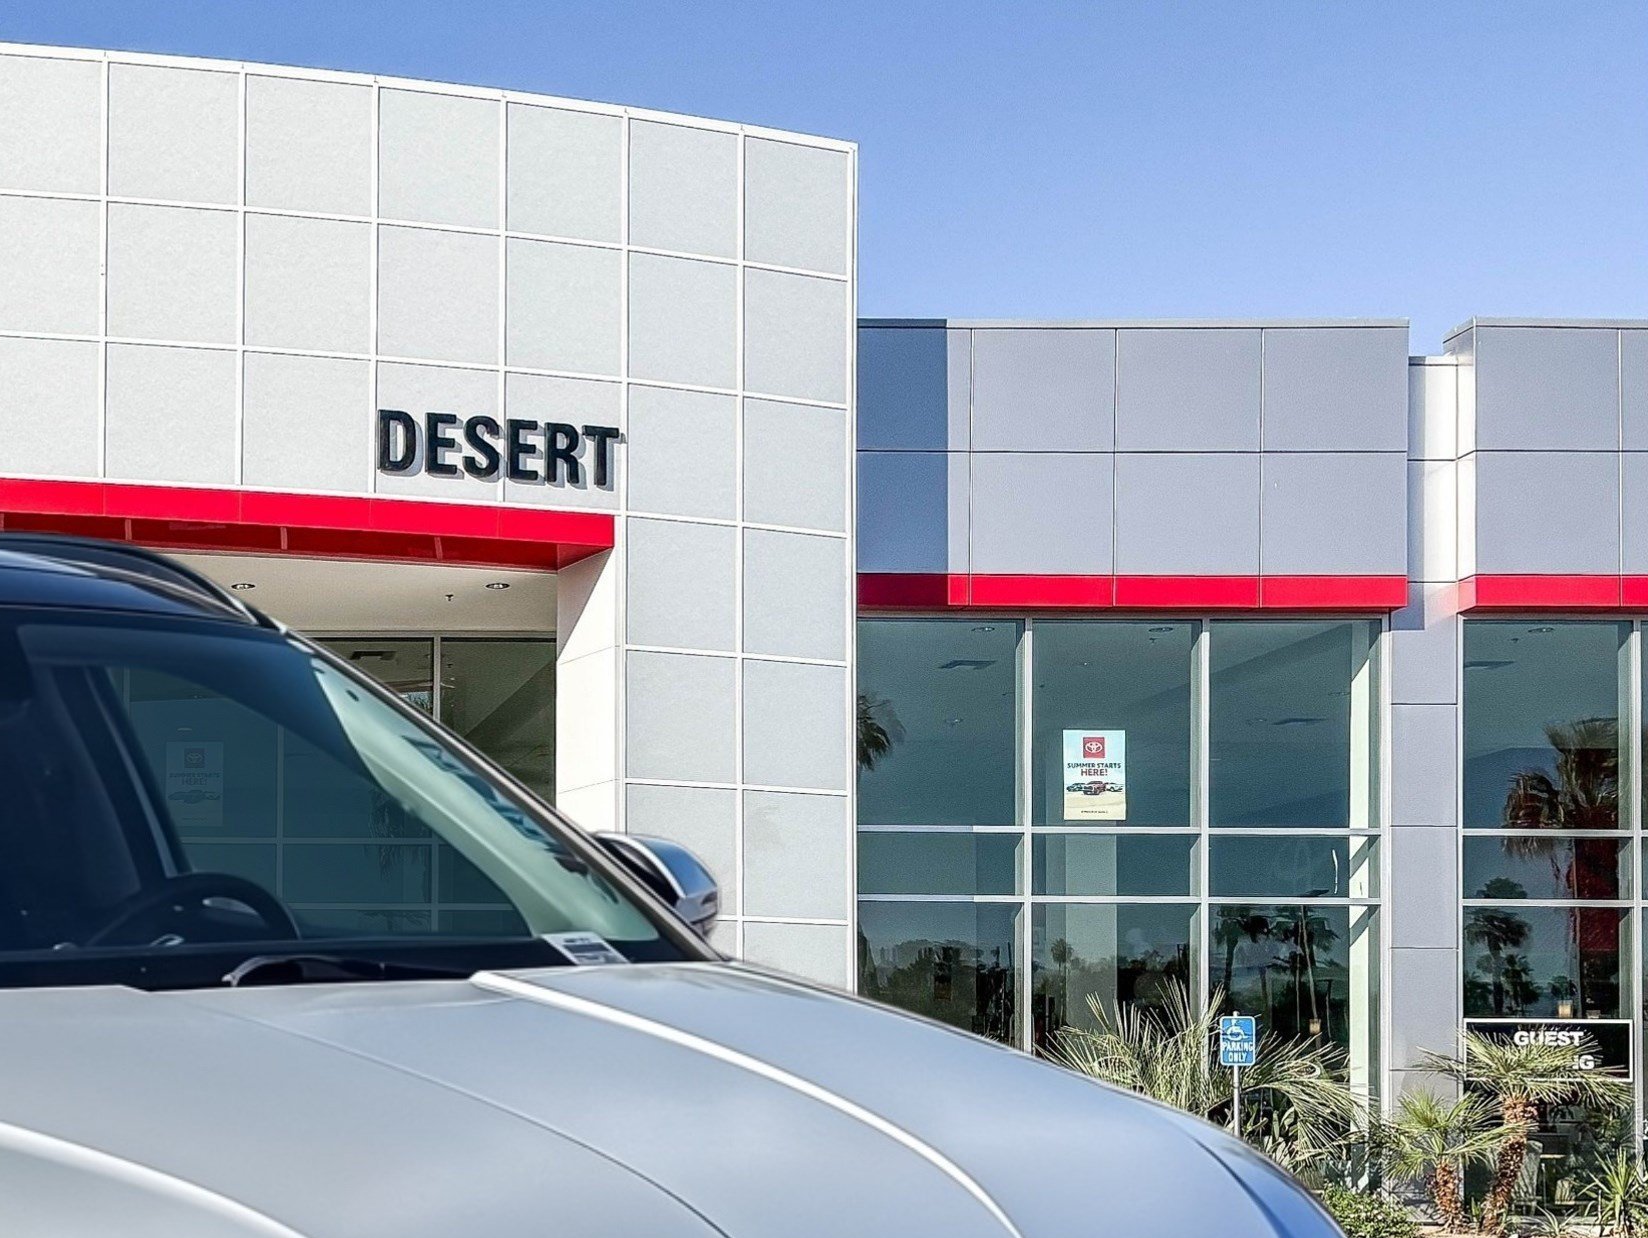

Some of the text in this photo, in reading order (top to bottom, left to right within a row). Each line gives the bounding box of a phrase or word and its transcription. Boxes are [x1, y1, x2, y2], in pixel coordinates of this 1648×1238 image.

[377, 409, 620, 486] DESERT
[1513, 1030, 1584, 1047] GUEST
[1222, 1041, 1254, 1051] PARKING
[1228, 1052, 1248, 1062] ONLY
